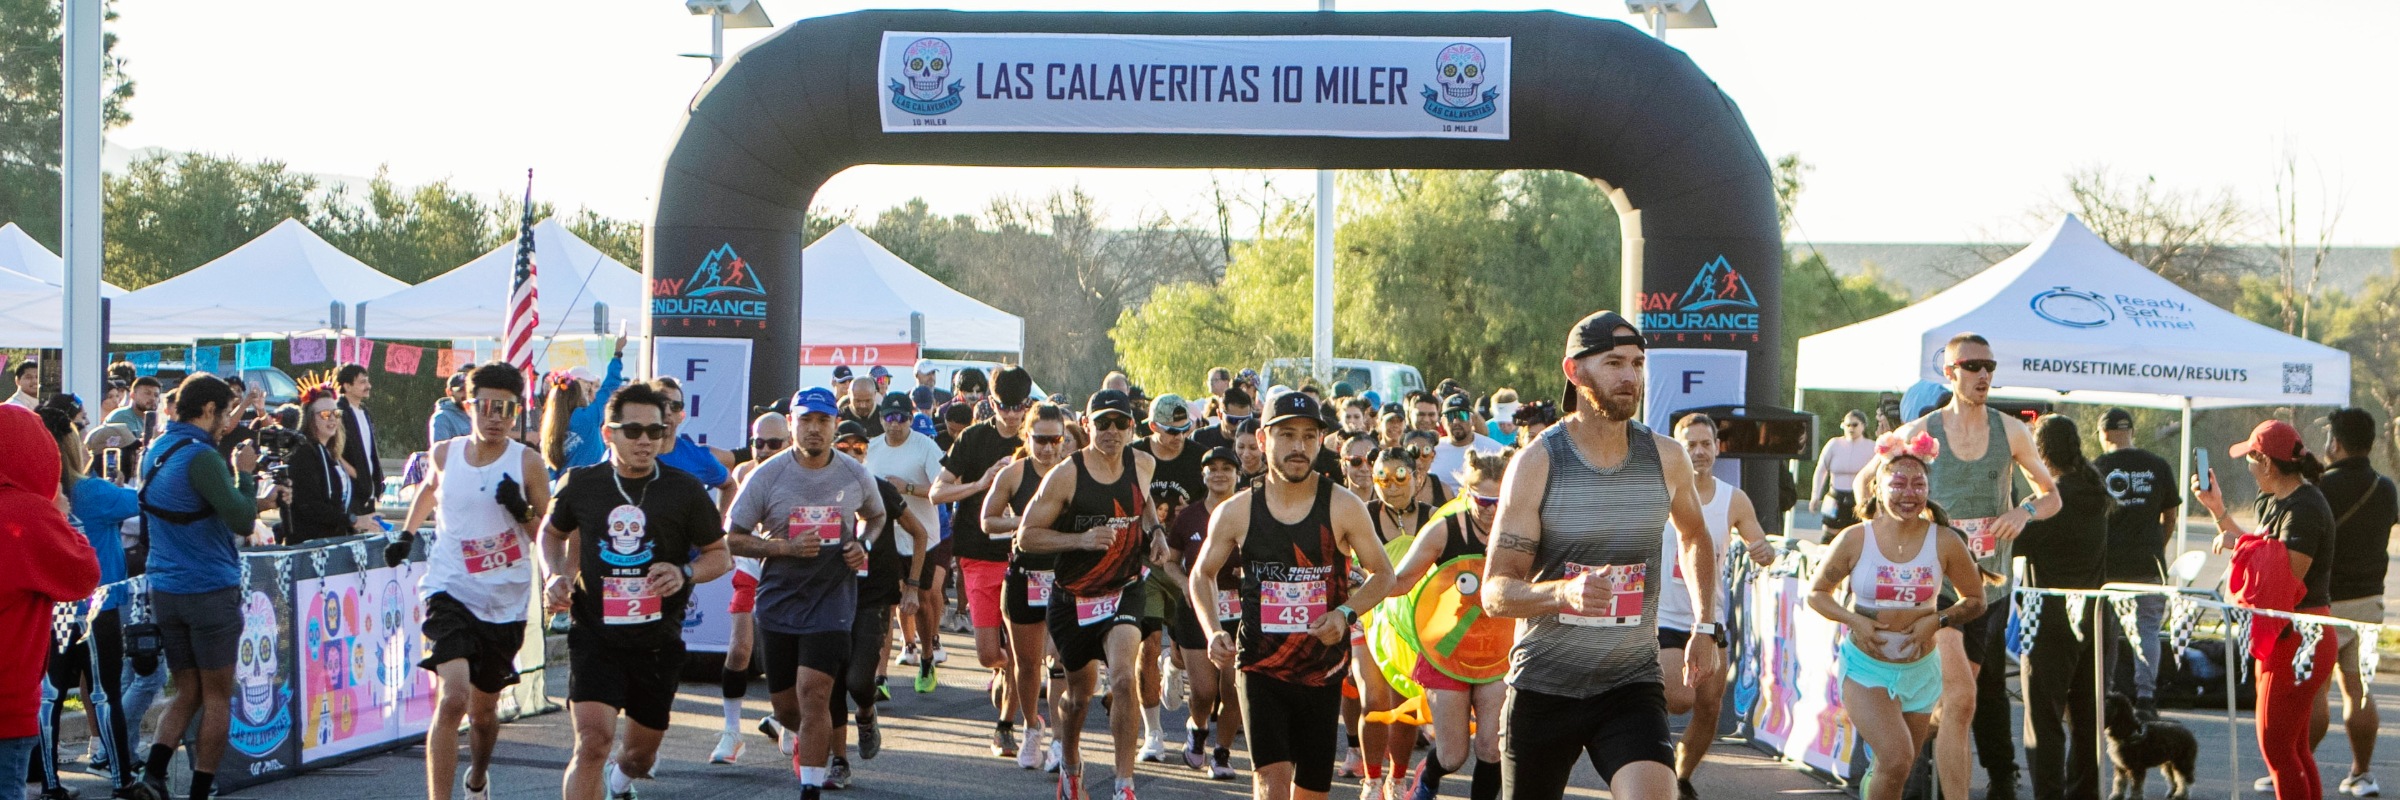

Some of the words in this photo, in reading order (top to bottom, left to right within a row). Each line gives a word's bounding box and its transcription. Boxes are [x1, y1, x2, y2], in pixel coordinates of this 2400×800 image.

[976, 62, 1034, 100] LAS
[1046, 63, 1260, 102] CALAVERITAS
[1272, 65, 1303, 103] 10
[1315, 66, 1408, 105] MILER
[896, 97, 910, 108] LAS
[912, 97, 958, 112] CALAVERITAS
[1427, 103, 1442, 115] LAS
[1443, 104, 1491, 119] CALAVERITAS
[650, 278, 684, 296] RAY
[649, 298, 767, 316] ENDURANCE
[1635, 292, 1678, 311] RAY
[2114, 294, 2193, 313] Ready,
[660, 319, 767, 329] VENTS
[1635, 313, 1759, 330] ENDURANCE
[2127, 316, 2196, 330] Time!
[1652, 333, 1759, 343] VENTS
[829, 346, 879, 364] AID
[2022, 357, 2248, 383] READYSETTIME.COM/RESULTS
[1150, 480, 1168, 489] ving
[481, 551, 508, 569] 40
[1288, 565, 1333, 575] RACING
[1893, 586, 1917, 601] 75
[627, 599, 641, 616] 2
[1091, 600, 1114, 616] 45
[1278, 605, 1310, 625] 43
